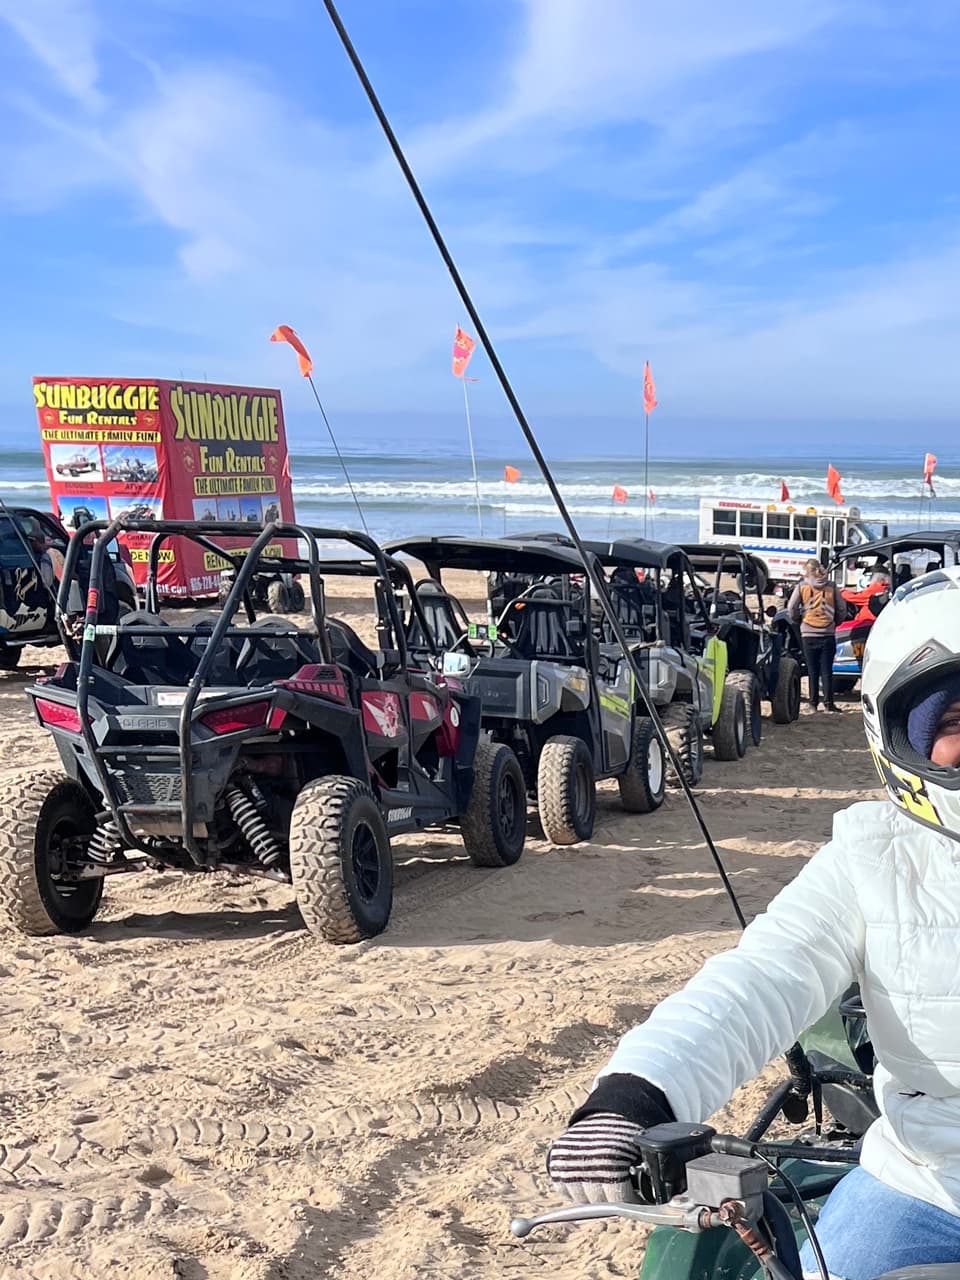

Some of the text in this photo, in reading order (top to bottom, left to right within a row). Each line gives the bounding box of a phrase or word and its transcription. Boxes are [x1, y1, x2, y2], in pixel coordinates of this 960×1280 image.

[33, 382, 160, 410] SUNBUGGIE
[170, 386, 279, 441] SUNBUGGIE
[44, 430, 158, 441] THE ULTIMATE FAMILY FUN!
[195, 478, 208, 494] THE
